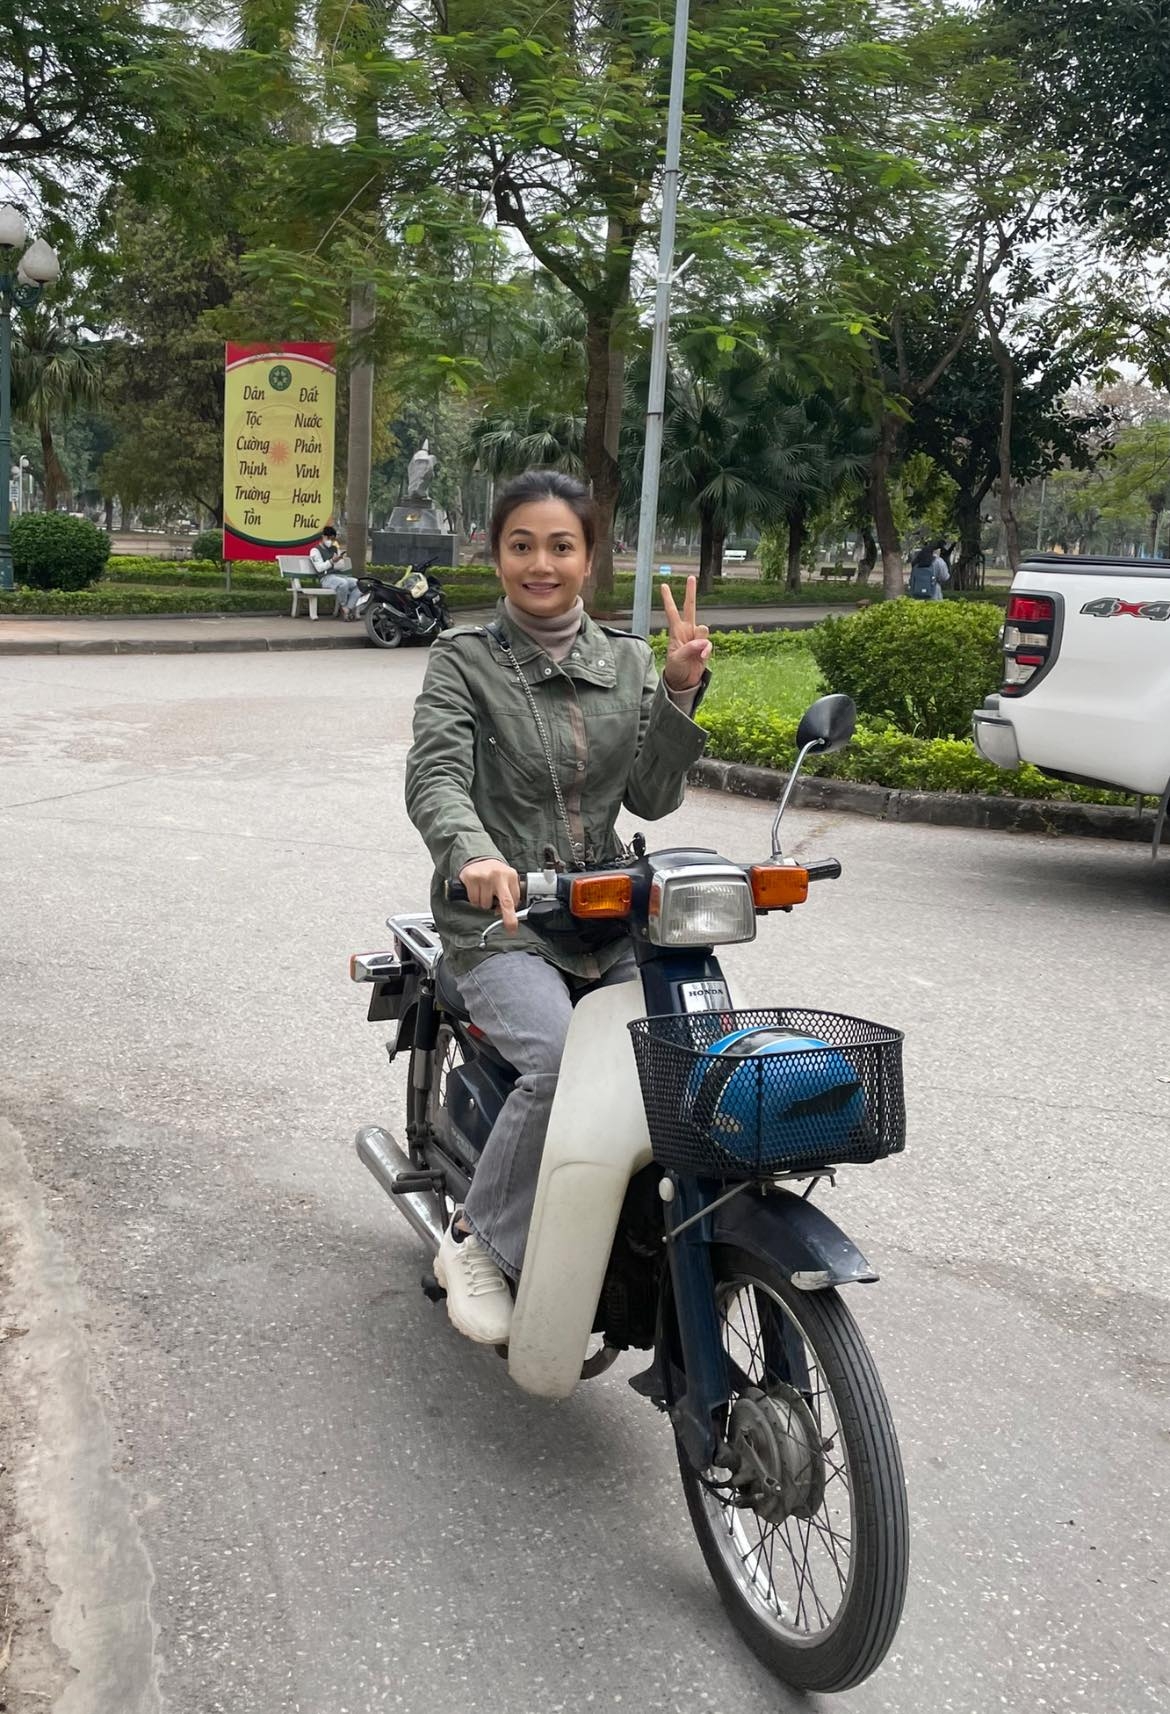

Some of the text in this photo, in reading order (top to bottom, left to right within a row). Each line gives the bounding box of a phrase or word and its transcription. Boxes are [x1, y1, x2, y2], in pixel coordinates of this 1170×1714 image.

[243, 385, 264, 400] Dân
[299, 386, 319, 402] Đất
[246, 411, 262, 428] Tộc
[294, 414, 322, 428] Nước
[236, 436, 270, 454] Cường
[294, 436, 322, 453] Phồn
[240, 461, 267, 478] Thịnh
[235, 486, 270, 504] Trường
[292, 488, 321, 506] Hạnh
[244, 508, 262, 525] Tồn
[293, 514, 320, 528] Phúc
